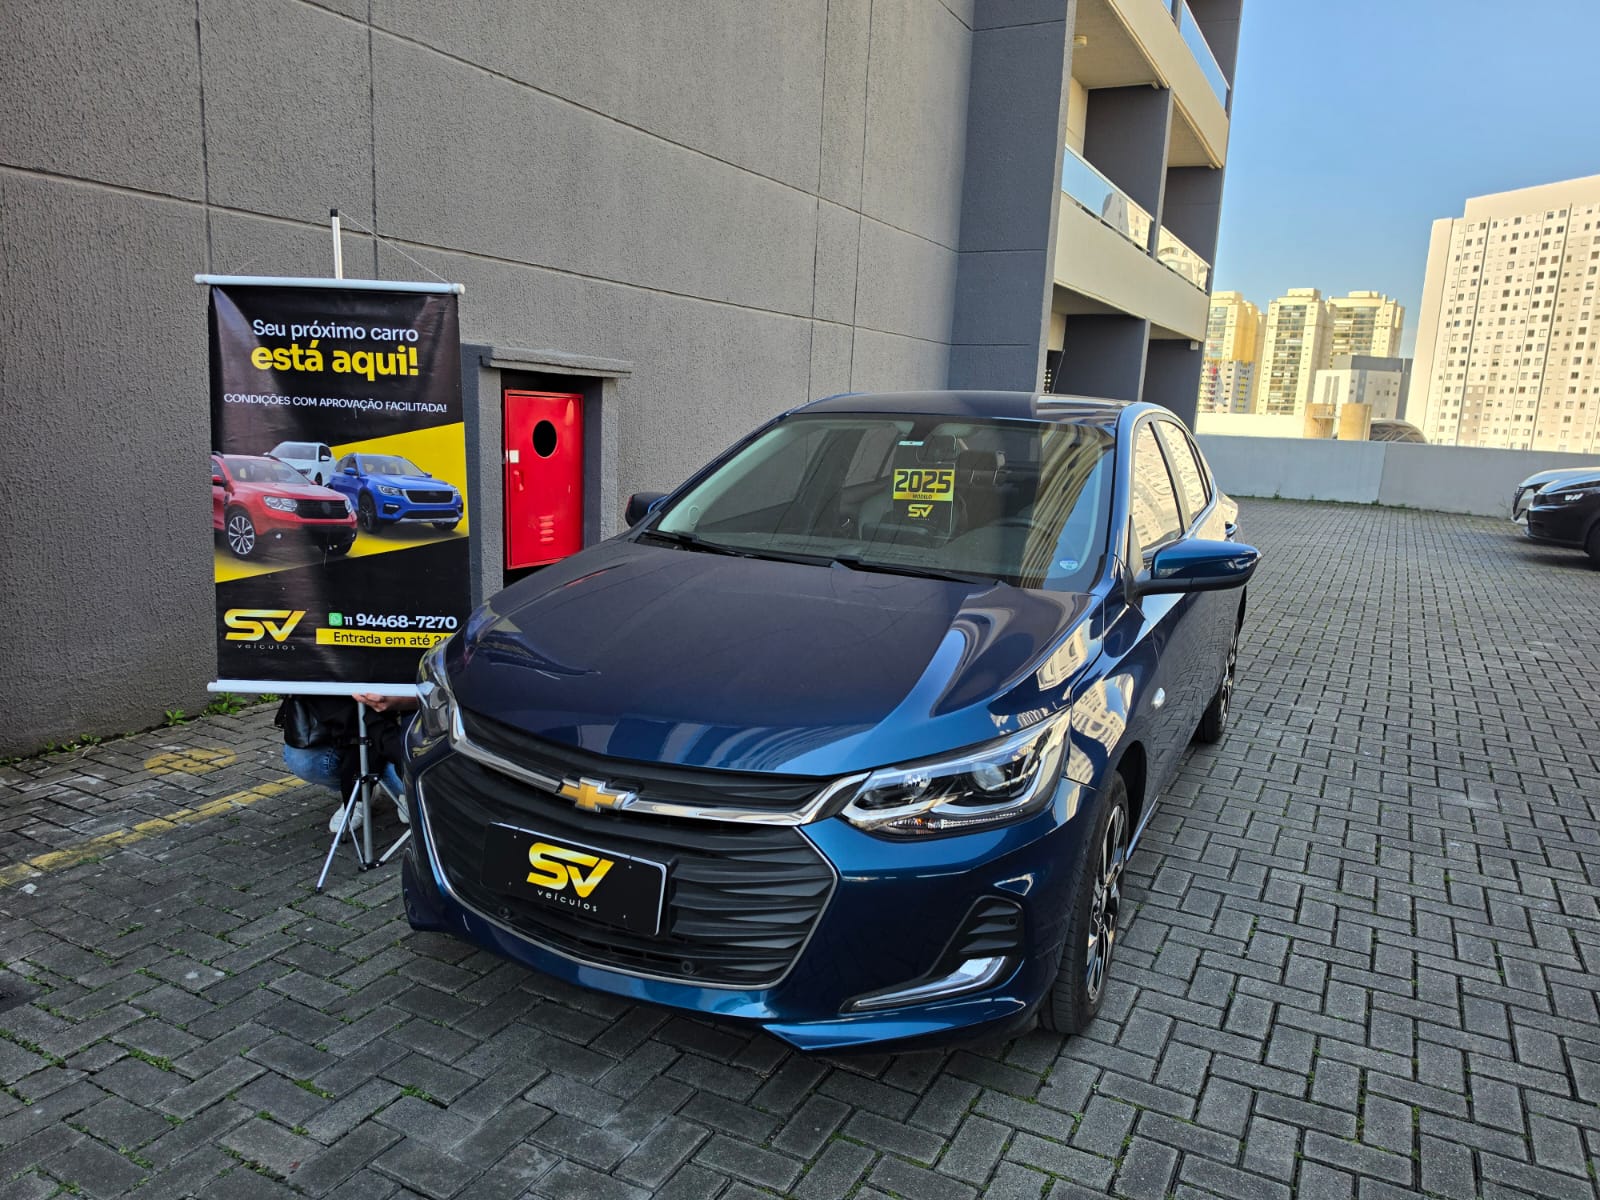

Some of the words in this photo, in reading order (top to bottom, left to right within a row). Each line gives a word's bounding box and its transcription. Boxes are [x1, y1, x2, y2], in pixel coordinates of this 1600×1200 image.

[253, 319, 286, 337] Seu
[291, 320, 366, 341] próximo
[370, 326, 420, 342] carro
[251, 340, 324, 372] está
[331, 345, 419, 381] aqui!
[223, 392, 291, 407] CONDIÇÕES
[292, 395, 318, 407] COM
[319, 397, 384, 411] APROVAÇÃO
[385, 401, 448, 413] FACILITADA!
[895, 470, 952, 493] 2025
[908, 503, 934, 518] SV
[224, 608, 306, 643] SV
[344, 616, 353, 625] 11
[356, 612, 458, 630] 94468-7270
[333, 631, 382, 645] Entrada
[387, 636, 406, 646] em
[409, 634, 431, 647] até
[526, 842, 615, 899] SV
